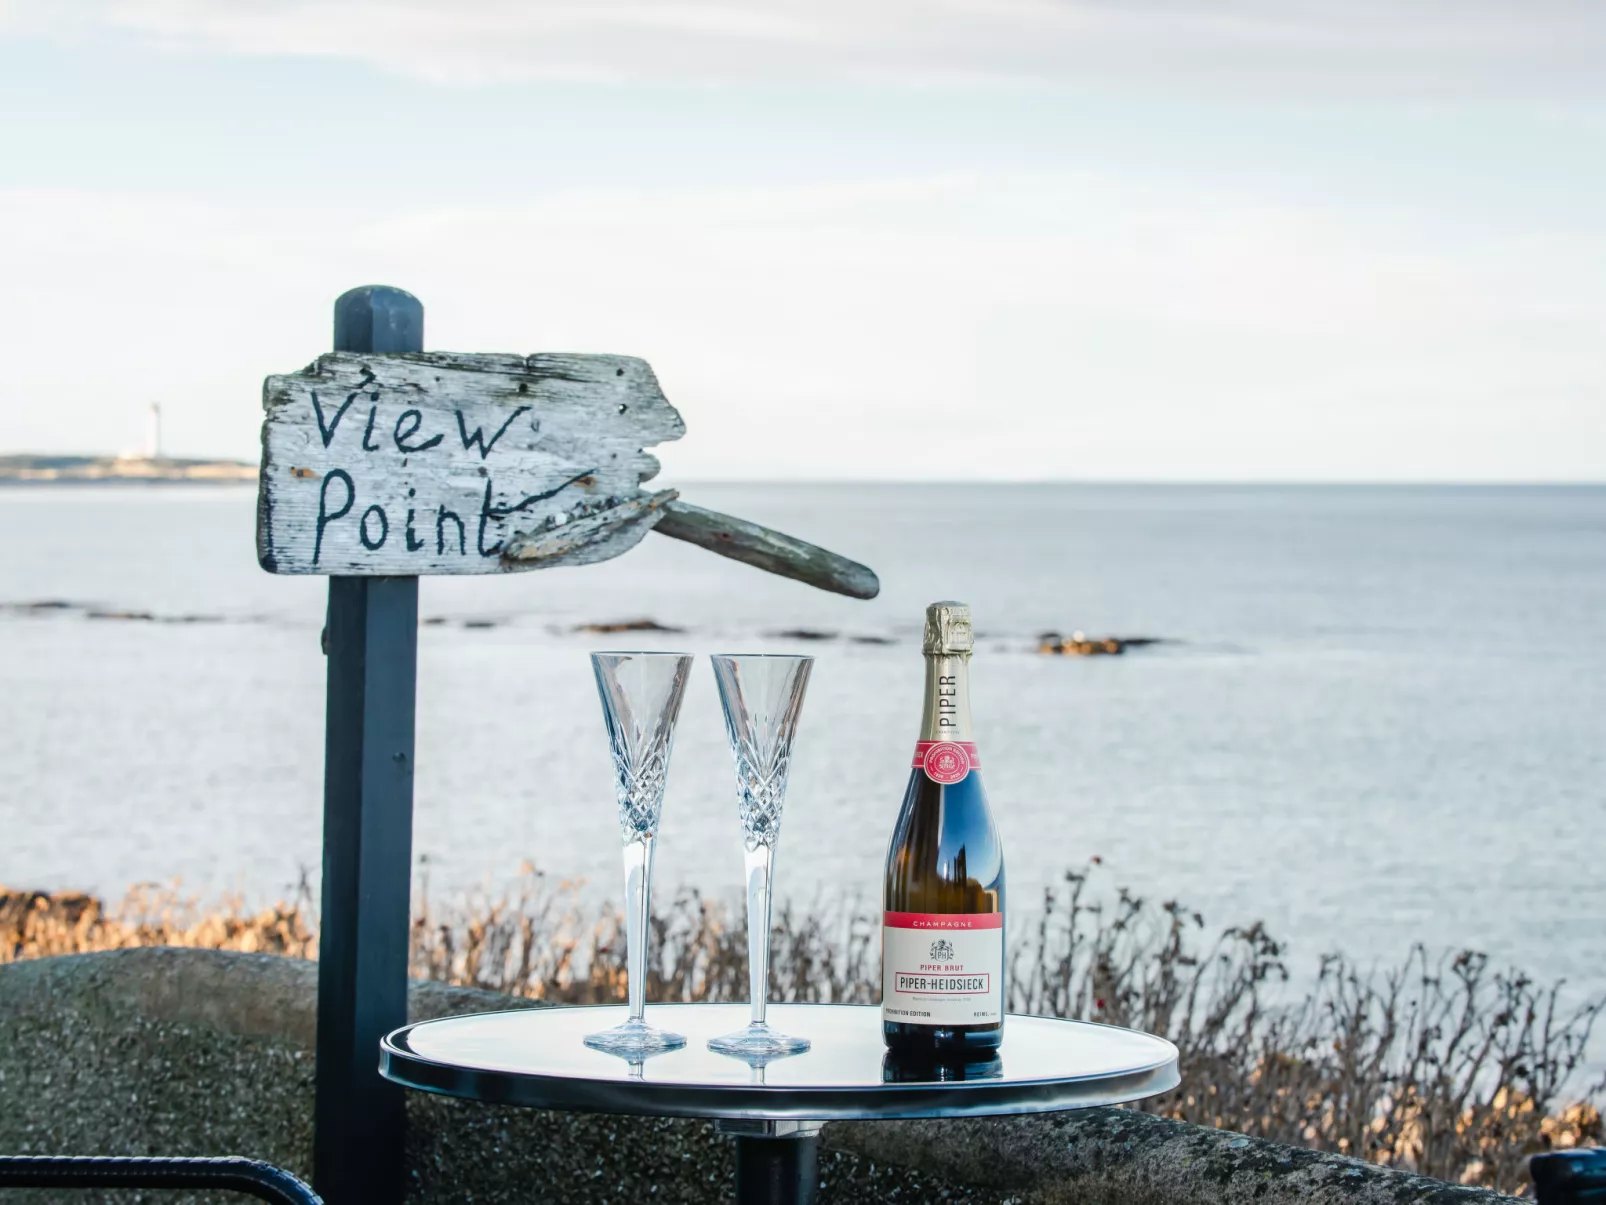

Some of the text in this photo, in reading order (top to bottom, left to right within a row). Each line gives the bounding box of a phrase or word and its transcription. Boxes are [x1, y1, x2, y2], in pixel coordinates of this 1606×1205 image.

[310, 387, 533, 460] View
[313, 468, 599, 565] Point
[939, 676, 956, 727] PIPER
[900, 976, 984, 990] PIPER-HEIDSIECK
[945, 964, 964, 972] BRUT
